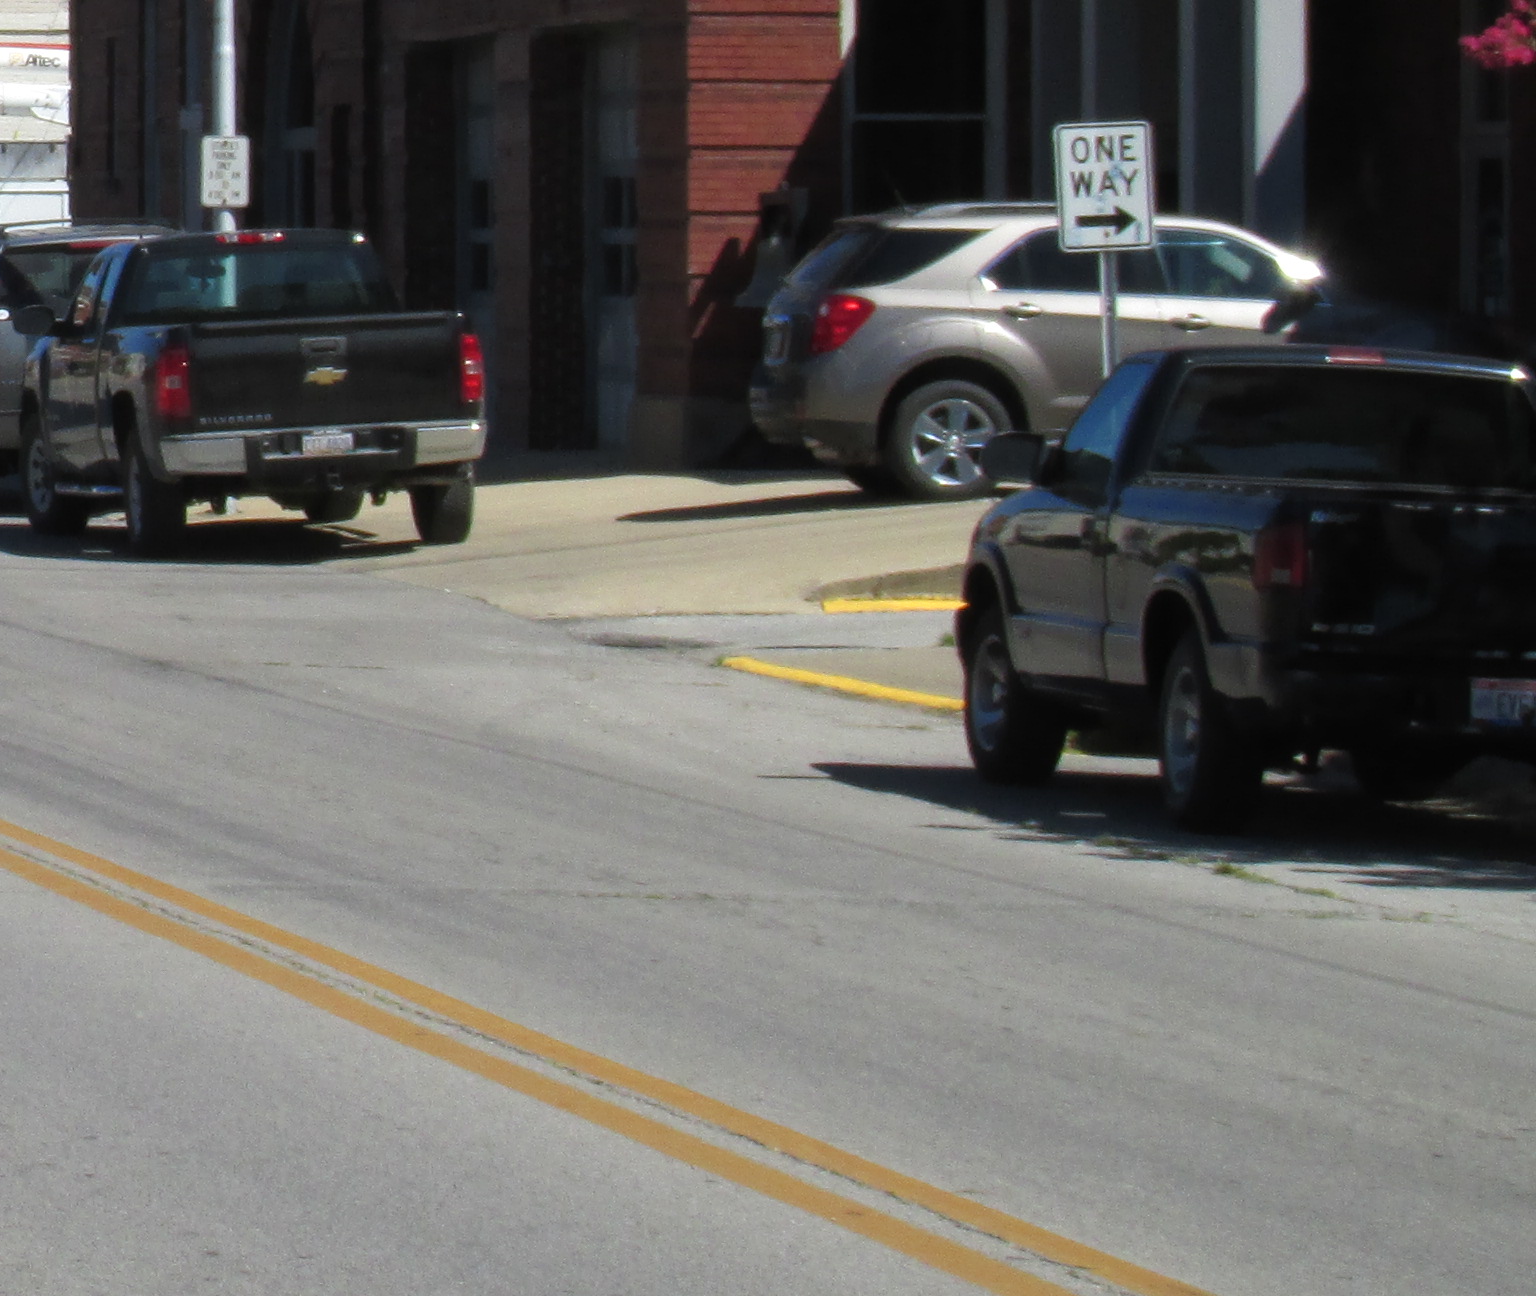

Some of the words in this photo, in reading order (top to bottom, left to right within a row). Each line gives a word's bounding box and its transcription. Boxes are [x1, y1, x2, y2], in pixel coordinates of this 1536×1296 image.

[25, 53, 61, 68] Altec
[1070, 134, 1139, 164] ONE
[1070, 168, 1140, 198] WAY
